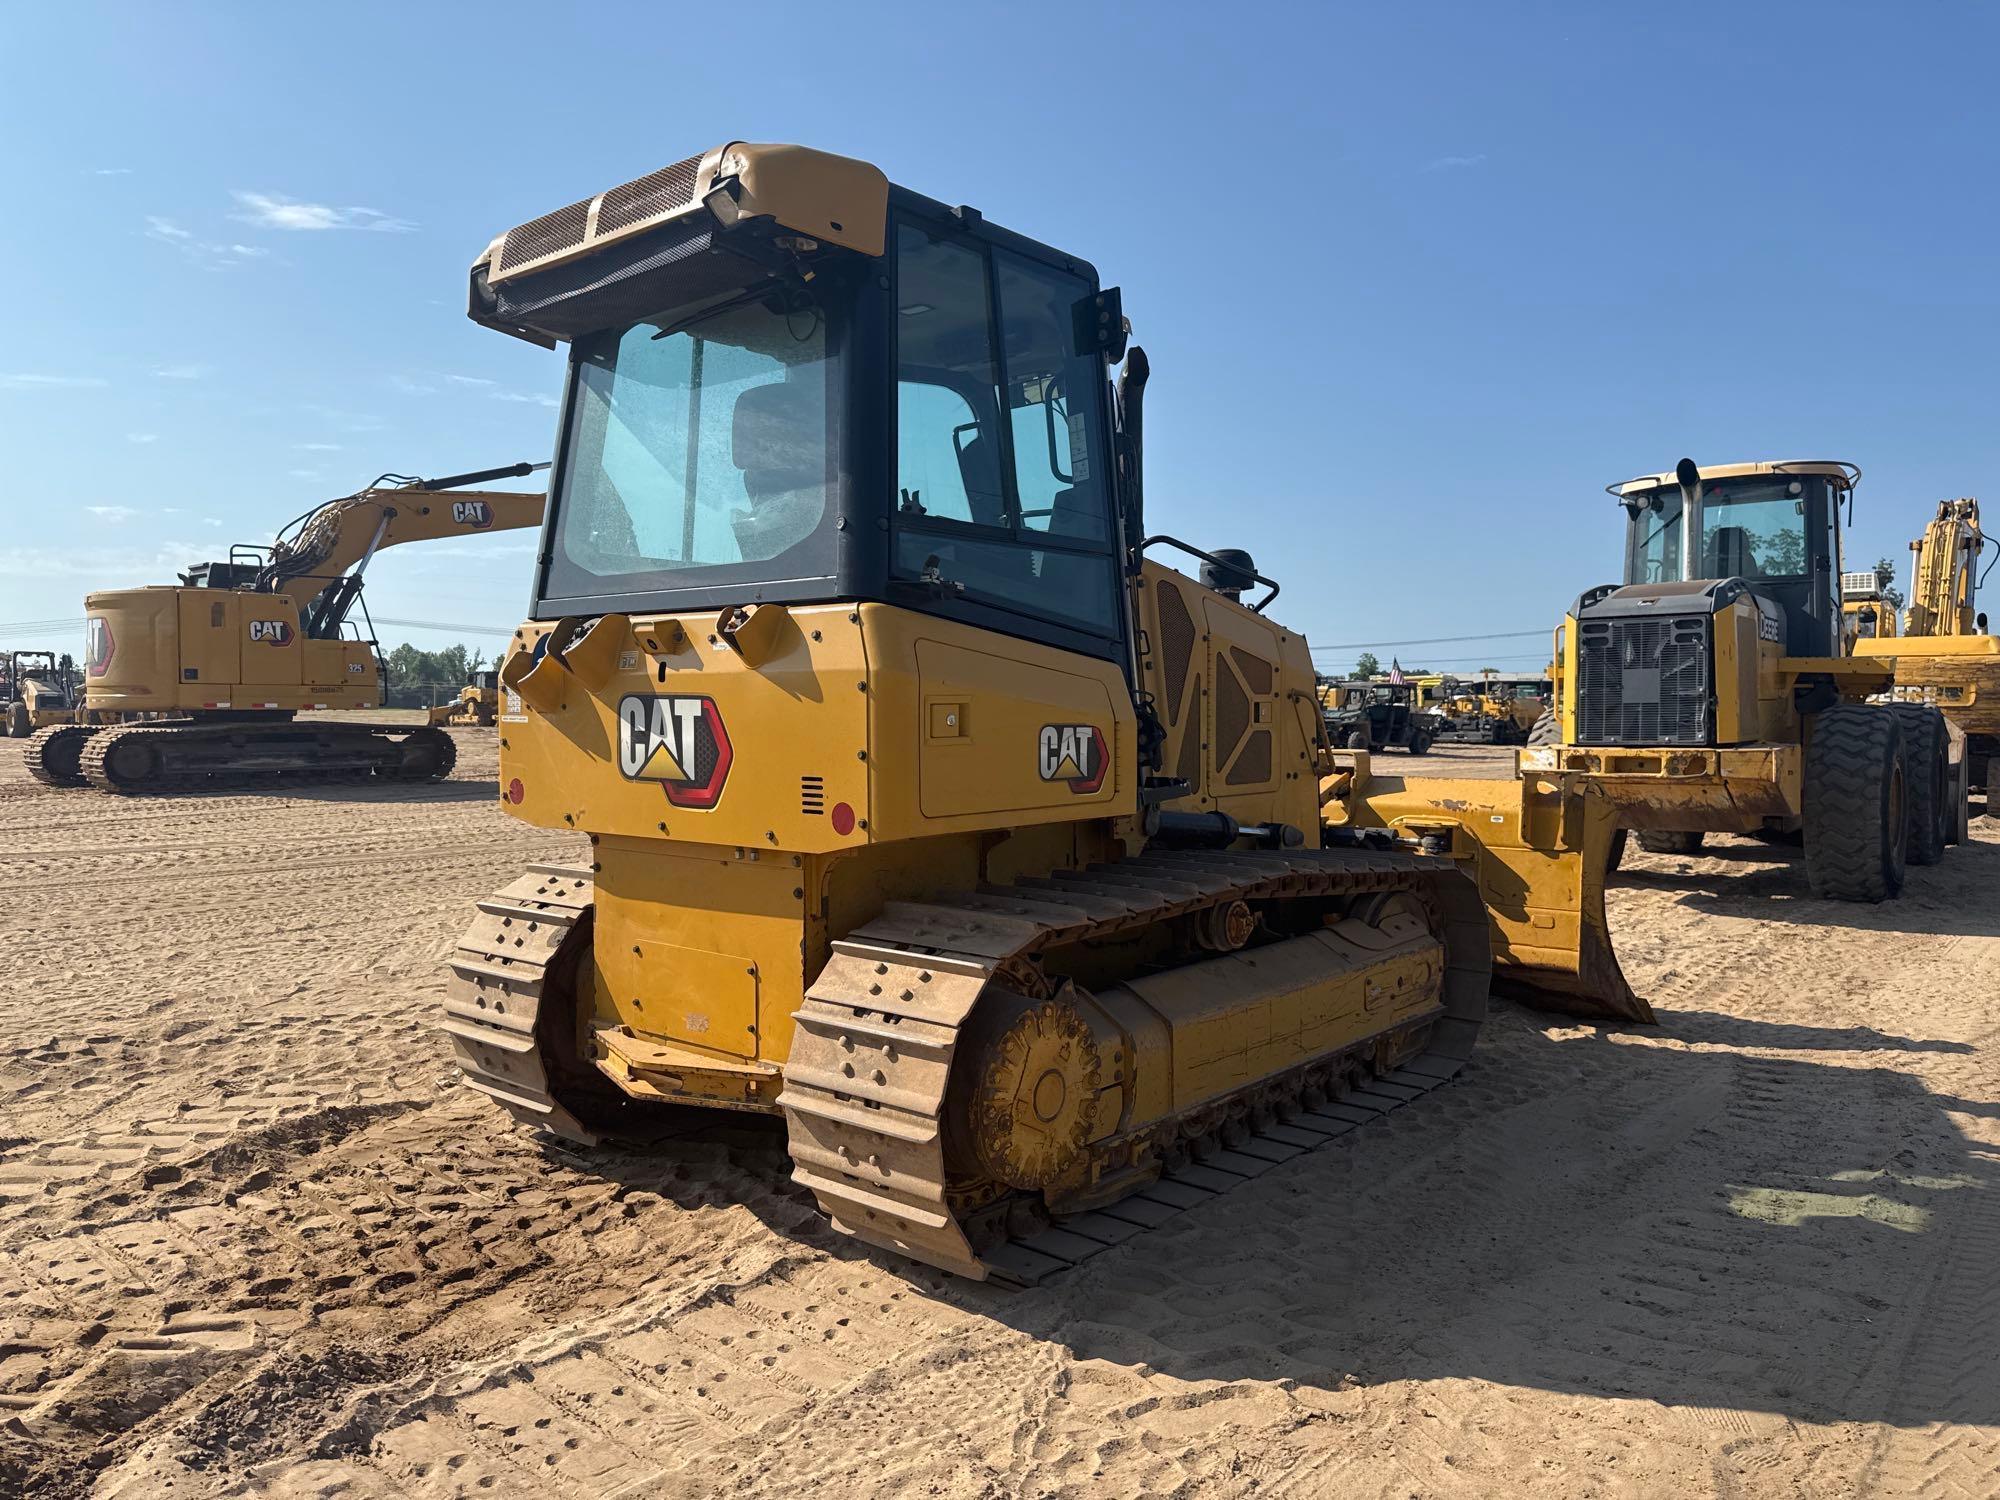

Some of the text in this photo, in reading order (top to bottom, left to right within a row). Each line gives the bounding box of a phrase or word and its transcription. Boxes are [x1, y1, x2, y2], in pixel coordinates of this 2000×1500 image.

[452, 502, 484, 523] CAT
[249, 621, 283, 641] CAT
[1760, 612, 1778, 641] DEERE
[348, 663, 362, 673] 325
[620, 696, 702, 781] CAT
[1040, 726, 1093, 779] CAT
